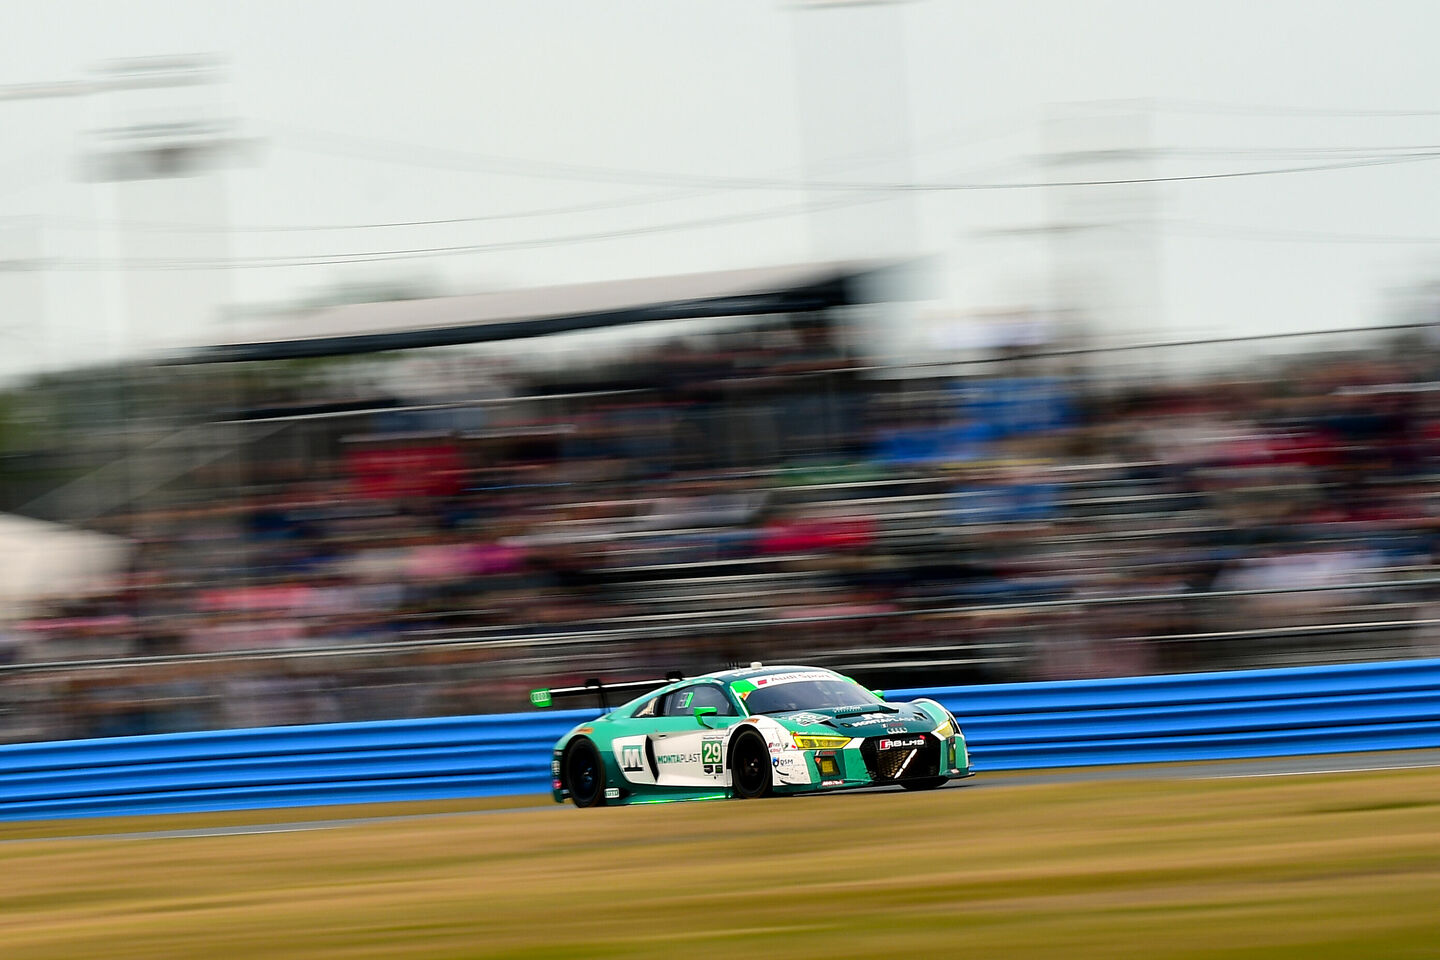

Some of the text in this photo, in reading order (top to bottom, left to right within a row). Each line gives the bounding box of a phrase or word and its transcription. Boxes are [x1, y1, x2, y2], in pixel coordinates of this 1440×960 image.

[704, 742, 722, 763] 29
[656, 753, 701, 764] MONTAPLAST
[781, 758, 794, 766] QSM
